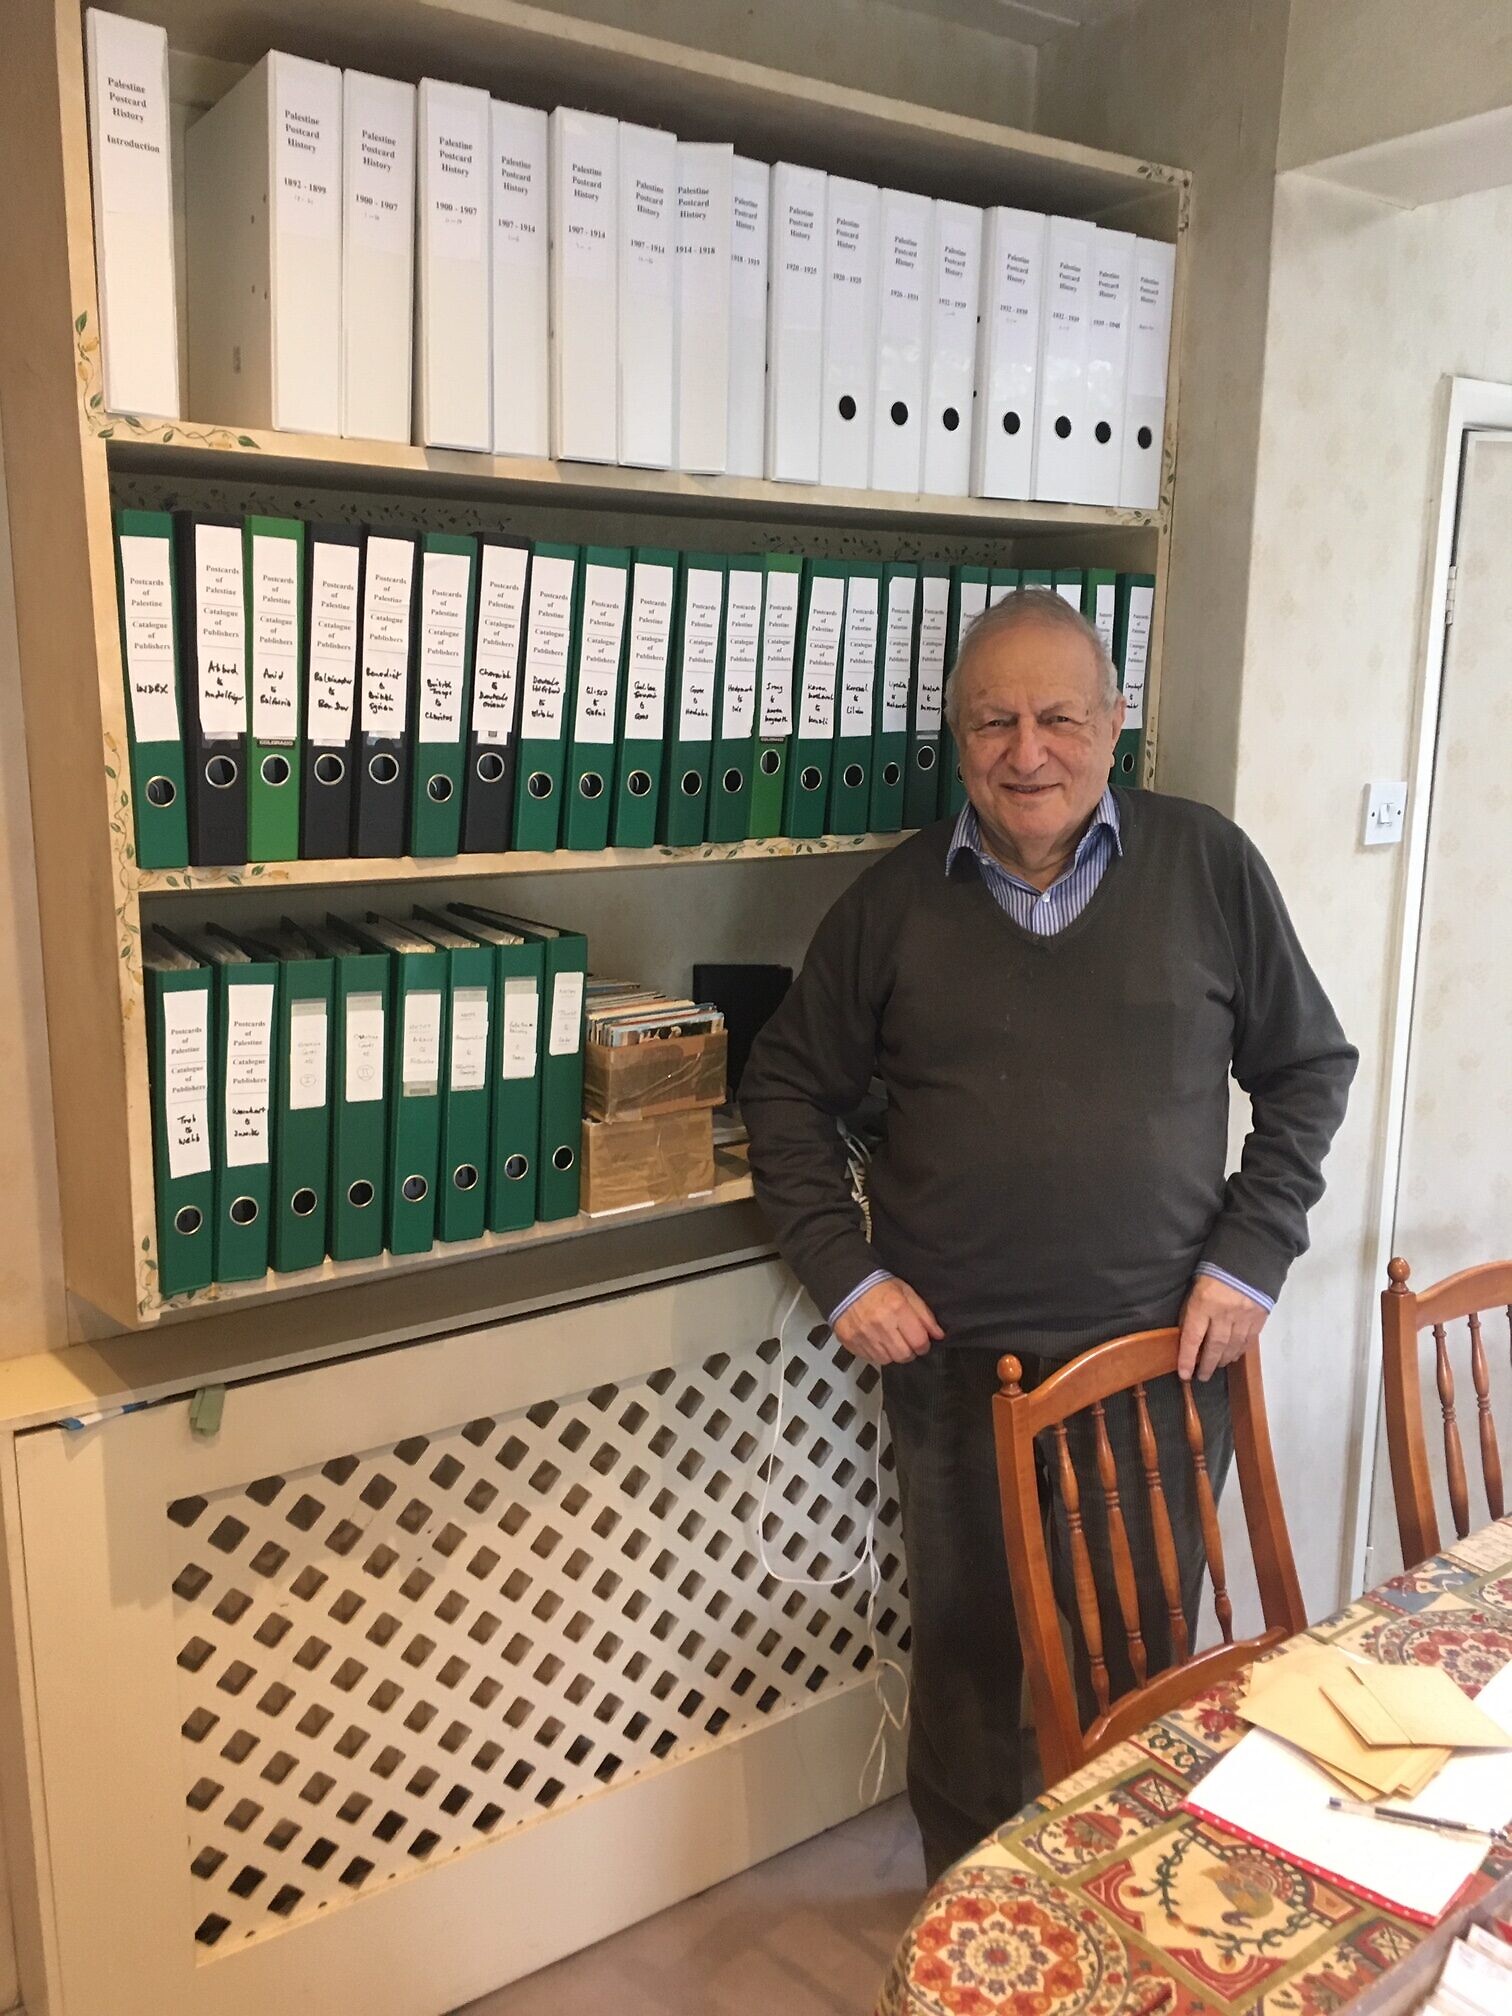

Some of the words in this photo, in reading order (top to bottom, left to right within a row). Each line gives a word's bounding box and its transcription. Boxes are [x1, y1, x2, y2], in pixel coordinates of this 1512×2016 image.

[107, 77, 146, 94] Palestine
[109, 91, 147, 108] Postcard
[112, 107, 144, 123] History
[284, 109, 320, 125] Palestine
[285, 123, 320, 140] Postcard
[361, 129, 397, 146] Palestine
[107, 134, 160, 153] Introduction
[287, 137, 317, 154] History
[439, 136, 473, 151] Palestine
[361, 143, 396, 159] Postcard
[439, 149, 473, 164] Postcard
[363, 156, 391, 173] History
[501, 155, 532, 170] Palestine
[441, 163, 470, 178] History
[501, 168, 532, 182] Postcard
[572, 163, 603, 177] Palestine
[572, 175, 603, 189] Postcard
[635, 179, 665, 194] Palestine
[503, 181, 529, 196] History
[677, 186, 710, 195] Palestine
[573, 188, 600, 202] History
[635, 191, 664, 206] Postcard
[355, 193, 374, 205] 1900
[380, 200, 399, 211] 1907
[678, 198, 710, 207] Postcard
[734, 196, 759, 209] Palestine
[436, 201, 454, 211] 1900
[460, 205, 478, 215] 1907
[636, 204, 661, 219] History
[788, 205, 815, 218] Palestine
[679, 210, 707, 221] History
[734, 208, 758, 220] Postcard
[498, 218, 515, 228] 1907
[520, 223, 536, 233] 1914
[735, 219, 756, 232] History
[788, 217, 814, 229] Postcard
[836, 217, 860, 229] Palestine
[568, 224, 585, 234] 1907
[590, 229, 606, 239] 1914
[790, 229, 811, 241] History
[835, 228, 860, 240] Postcard
[630, 239, 646, 248] 1907
[650, 244, 665, 254] 1914
[675, 245, 693, 254] 1914
[699, 246, 716, 255] 1918
[836, 239, 857, 252] History
[205, 564, 240, 575] Postcards
[129, 577, 165, 586] Postcards
[215, 576, 224, 584] of
[262, 574, 295, 585] Postcards
[375, 574, 407, 585] Postcards
[205, 586, 237, 596] Palestine
[322, 580, 355, 592] Postcards
[489, 581, 520, 591] Postcards
[373, 594, 404, 604] Palestine
[431, 589, 463, 598] Postcards
[539, 590, 569, 601] Postcards
[131, 599, 163, 607] Palestine
[262, 595, 292, 605] Palestine
[320, 600, 351, 611] Palestine
[487, 599, 515, 610] Palestine
[546, 601, 555, 609] of
[591, 599, 620, 609] Postcards
[639, 598, 668, 607] Postcards
[691, 602, 717, 611] Postcards
[203, 607, 239, 618] Catalogue
[430, 608, 459, 618] Palestine
[537, 609, 565, 619] Palestine
[259, 615, 293, 626] Catalogue
[370, 614, 404, 624] Catalogue
[484, 619, 516, 630] Catalogue
[589, 618, 616, 627] Palestine
[638, 616, 664, 625] Palestine
[690, 620, 713, 628] Palestine
[132, 621, 168, 630] Catalogue
[269, 627, 278, 635] of
[317, 620, 352, 631] Catalogue
[202, 628, 240, 638] Publishers
[369, 633, 404, 643] Publishers
[427, 627, 460, 638] Catalogue
[534, 628, 565, 638] Catalogue
[259, 635, 294, 646] Publishers
[482, 637, 515, 648] Publishers
[586, 636, 616, 646] Catalogue
[636, 634, 665, 644] Catalogue
[688, 638, 714, 647] Catalogue
[134, 642, 171, 650] Publishers
[316, 640, 352, 651] Publishers
[533, 646, 564, 656] Publishers
[427, 647, 460, 657] Publishers
[635, 652, 665, 661] Publishers
[585, 655, 616, 664] Publishers
[688, 656, 715, 664] Publishers
[233, 1020, 266, 1028] Postcards
[170, 1027, 203, 1036] Postcards
[170, 1047, 201, 1055] Palestine
[232, 1058, 267, 1066] Catalogue
[170, 1066, 204, 1074] Catalogue
[245, 1067, 254, 1075] of
[171, 1085, 207, 1094] Publishers
